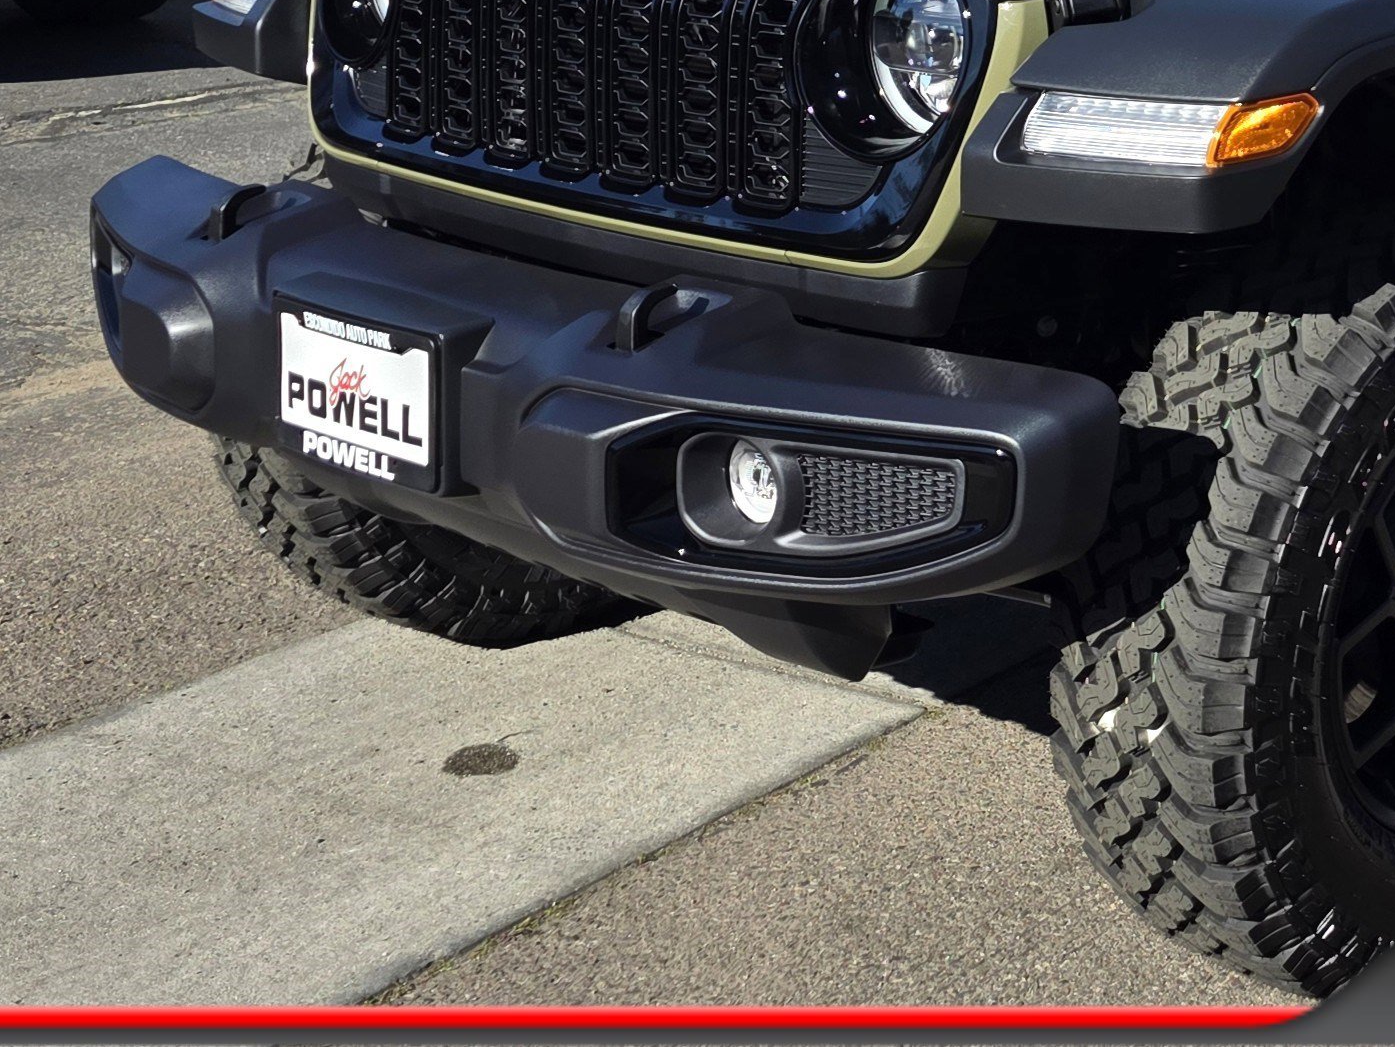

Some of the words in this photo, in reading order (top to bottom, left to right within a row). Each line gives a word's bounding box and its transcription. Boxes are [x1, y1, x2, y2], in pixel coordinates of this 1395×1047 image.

[345, 323, 367, 346] AUTO
[367, 329, 392, 350] PARK
[329, 357, 371, 406] Jack
[287, 369, 423, 448] POWELL
[303, 430, 395, 481] POWELL
